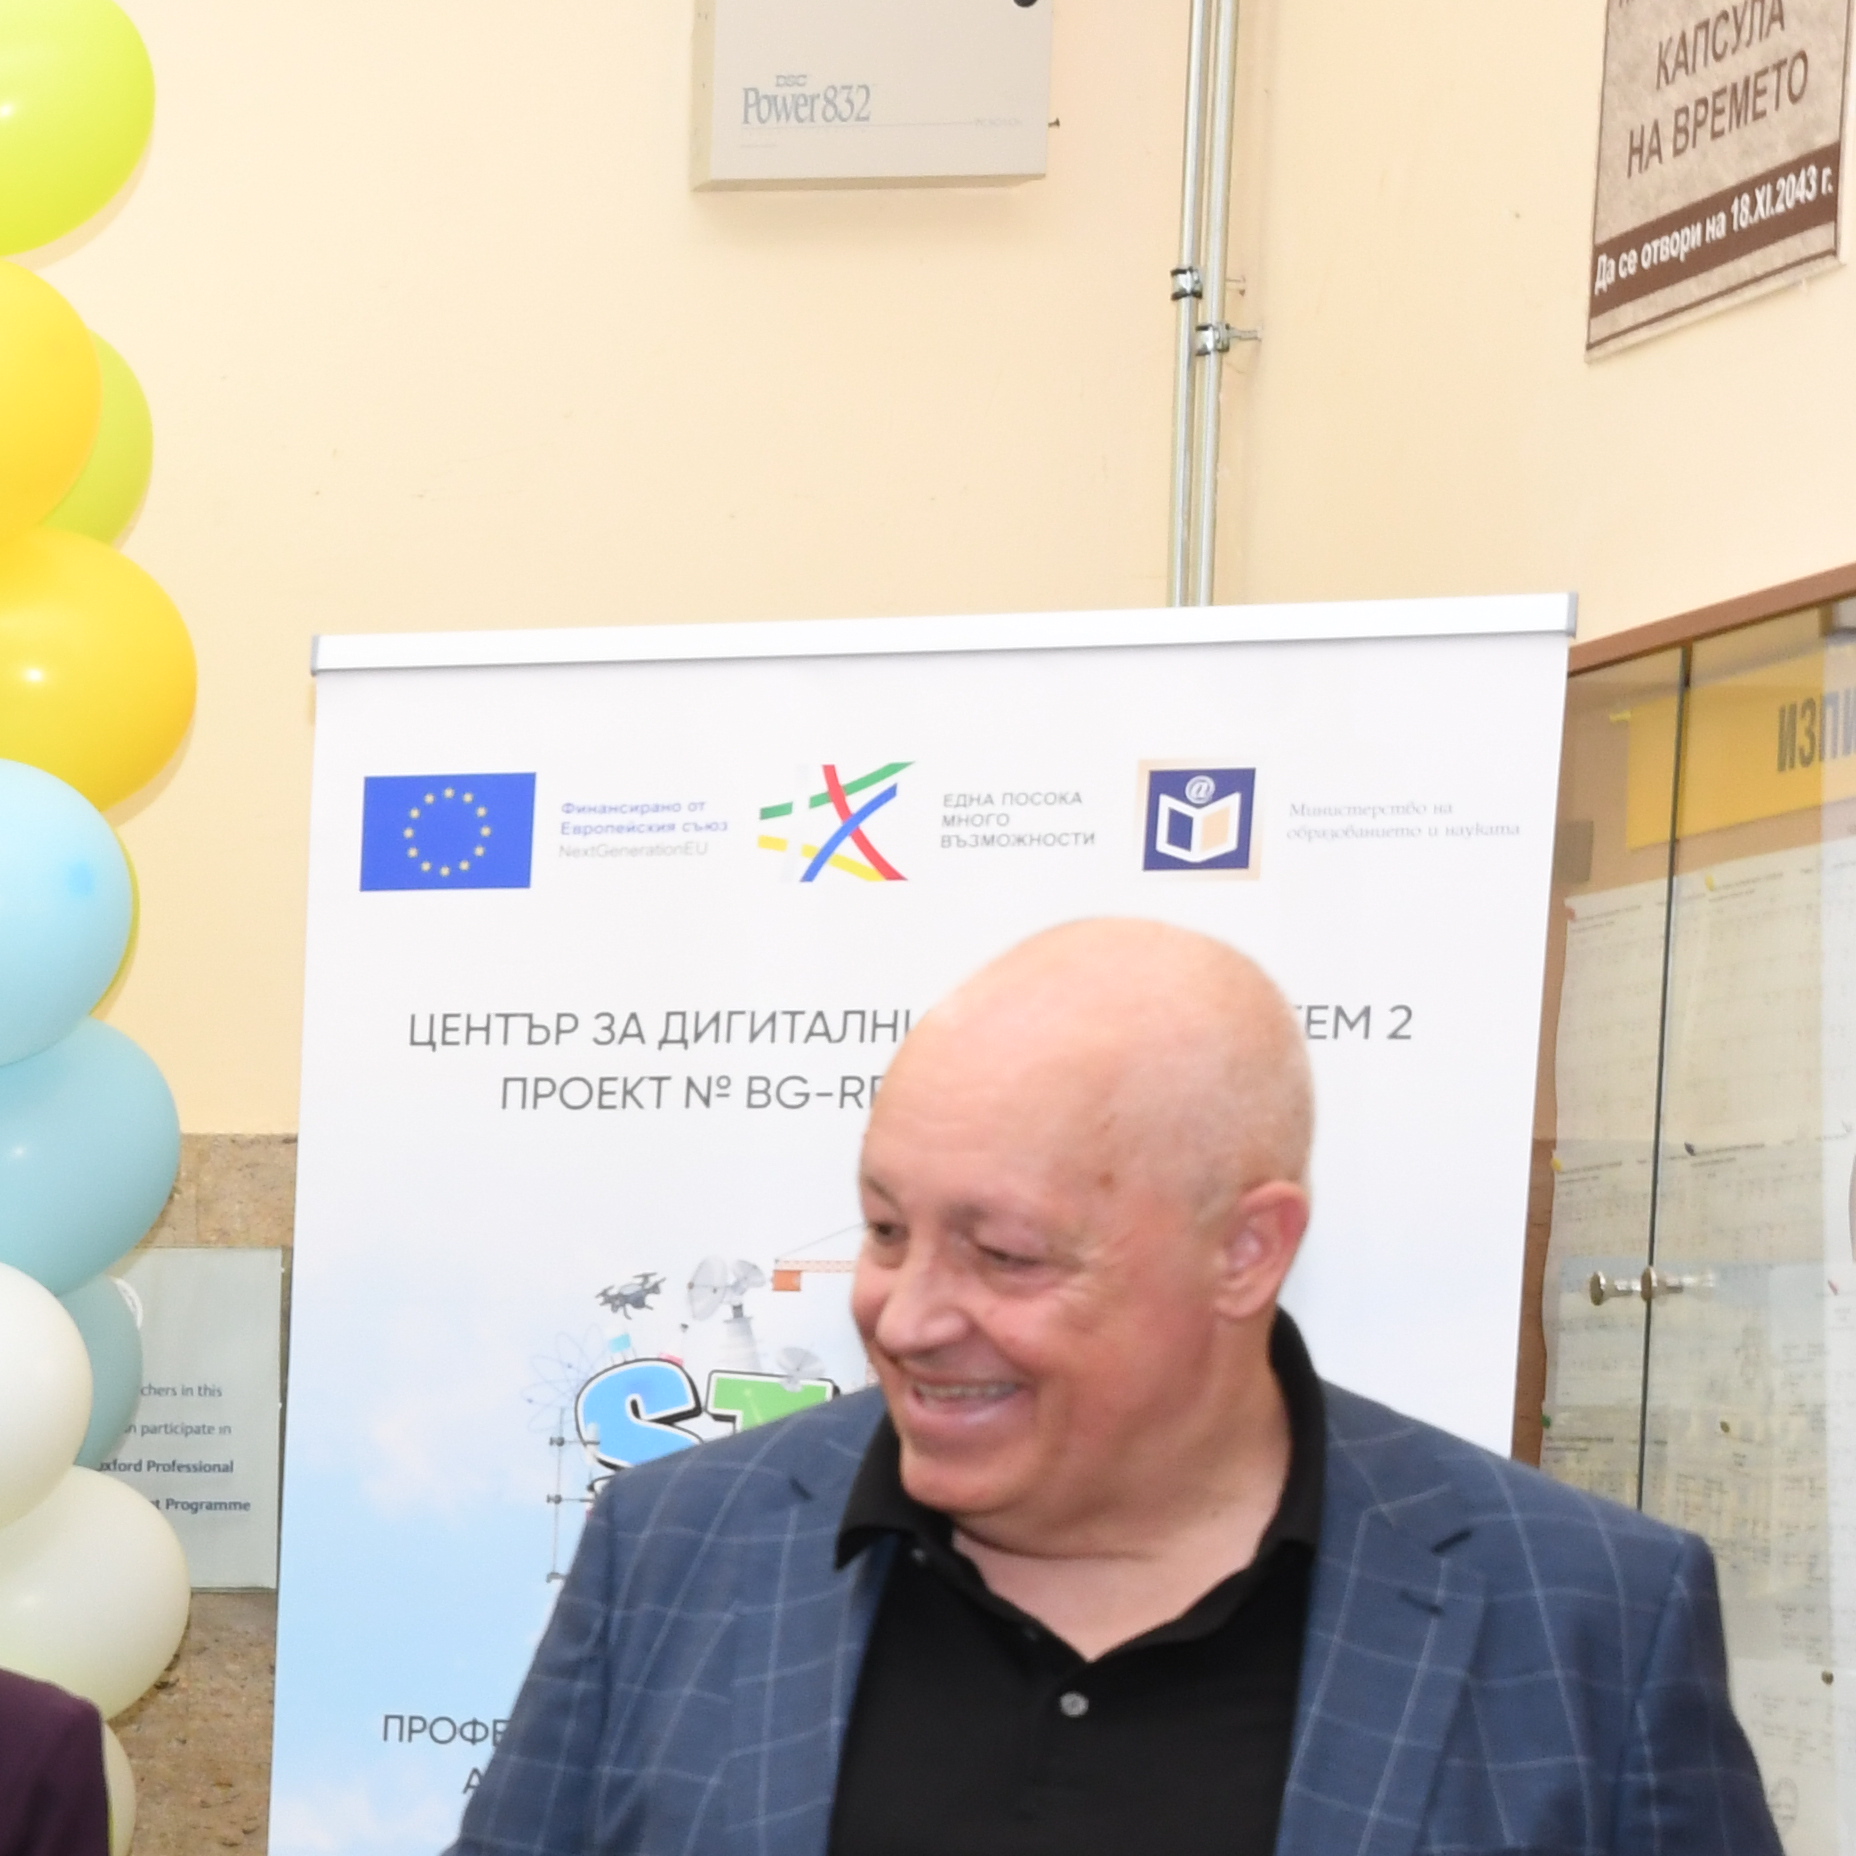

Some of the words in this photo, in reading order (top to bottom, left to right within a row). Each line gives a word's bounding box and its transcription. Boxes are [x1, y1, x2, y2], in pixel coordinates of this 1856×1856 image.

[1656, 0, 1785, 91] КАПСУЛА
[775, 75, 808, 87] DSC
[1628, 118, 1663, 179] НА
[1672, 49, 1809, 158] ВРЕМЕТО
[1594, 252, 1615, 296] Да
[1618, 249, 1637, 279] се
[1641, 222, 1702, 270] отвори
[1705, 211, 1726, 243] на
[560, 800, 682, 817] Финансирано
[688, 801, 707, 813] от
[943, 792, 995, 810] ЕДНА
[1001, 790, 1084, 808] ПОСОКА
[942, 812, 1010, 829] МНОГО
[558, 839, 709, 859] NextGenerationEU
[940, 831, 1097, 850] ВЪЗМОЖНОСТИ
[409, 1012, 579, 1052] ЦЕНТЪР
[592, 1012, 646, 1045] ЗА
[1386, 1004, 1413, 1040] 2
[501, 1074, 672, 1110] ПРОЕКТ
[684, 1074, 732, 1109] №
[181, 1384, 193, 1396] in
[198, 1384, 222, 1397] this
[141, 1422, 215, 1437] participate
[219, 1425, 231, 1434] in
[147, 1460, 234, 1473] Professional
[166, 1498, 251, 1514] Programme
